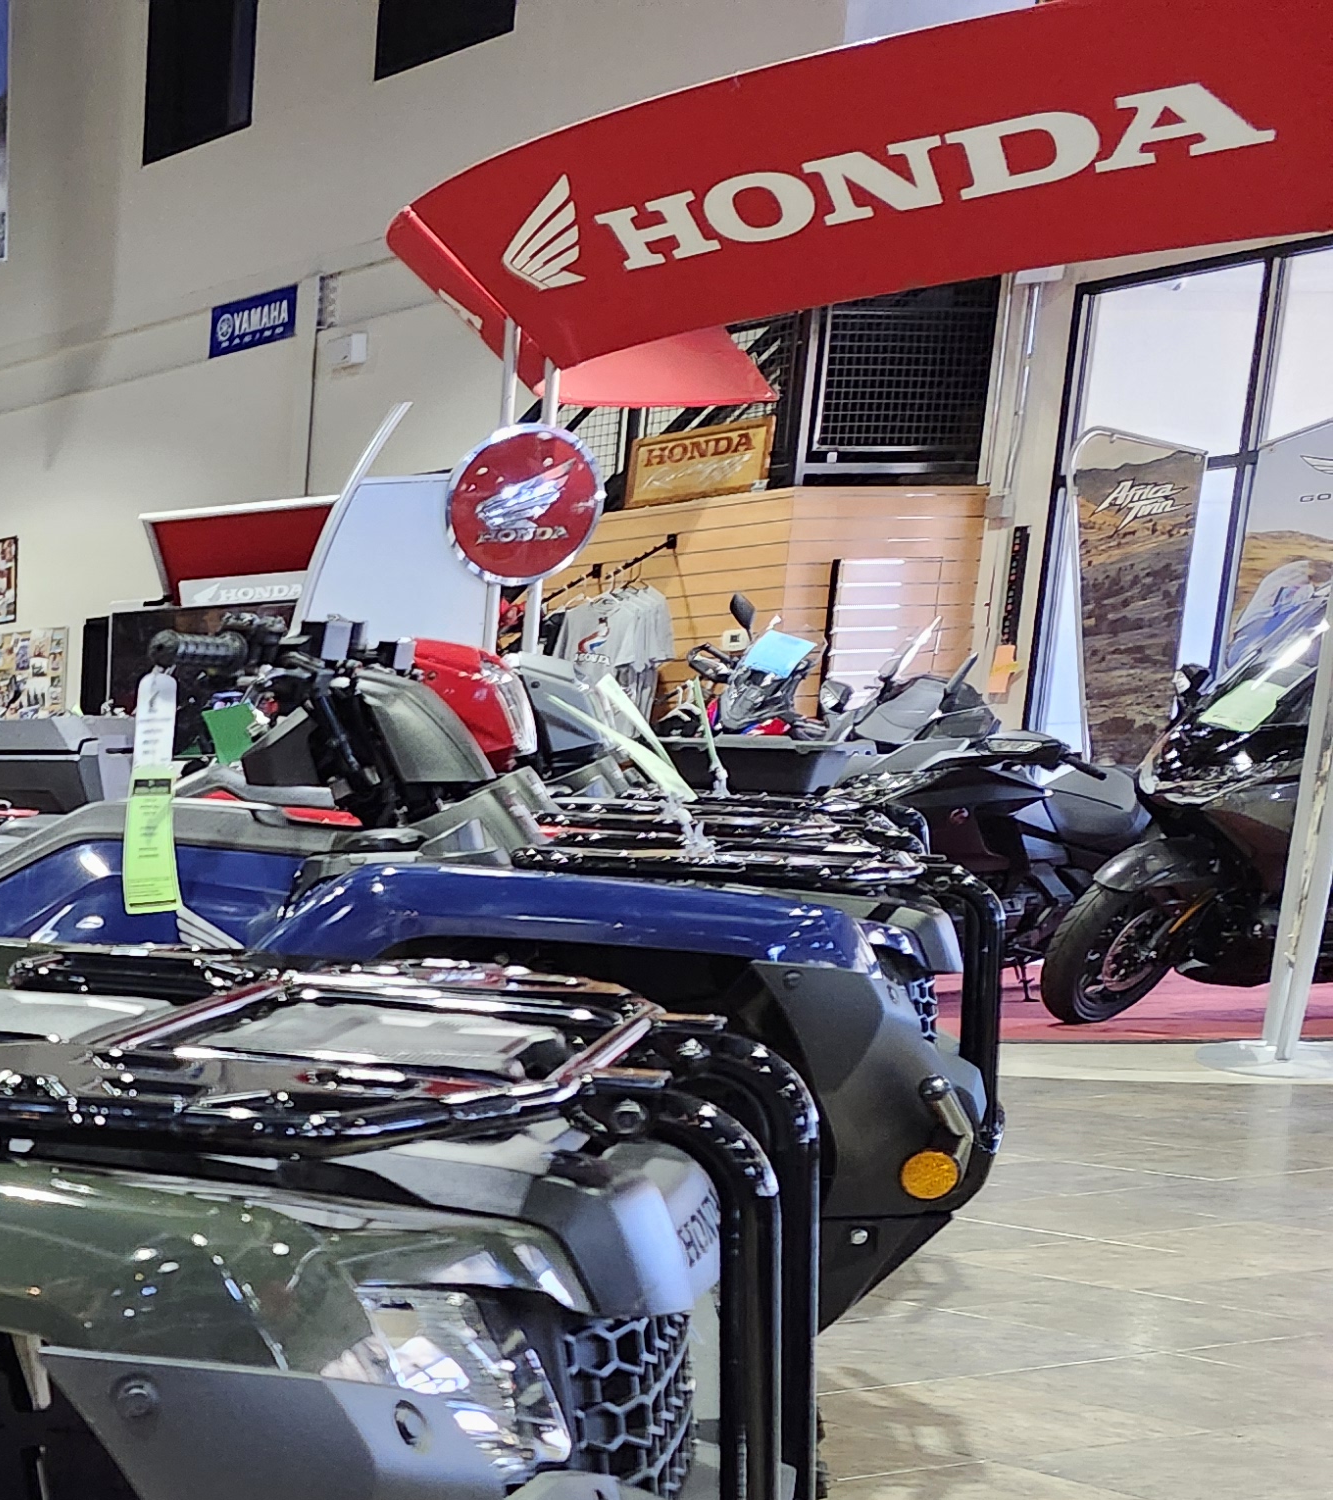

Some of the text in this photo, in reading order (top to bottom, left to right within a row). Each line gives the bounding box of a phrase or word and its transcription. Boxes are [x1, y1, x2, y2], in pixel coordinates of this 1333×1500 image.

[595, 81, 1277, 273] HONDA
[232, 299, 289, 336] YAMAHA
[642, 431, 757, 468] HONDA
[475, 525, 570, 545] HONDA
[219, 583, 303, 601] HONDA
